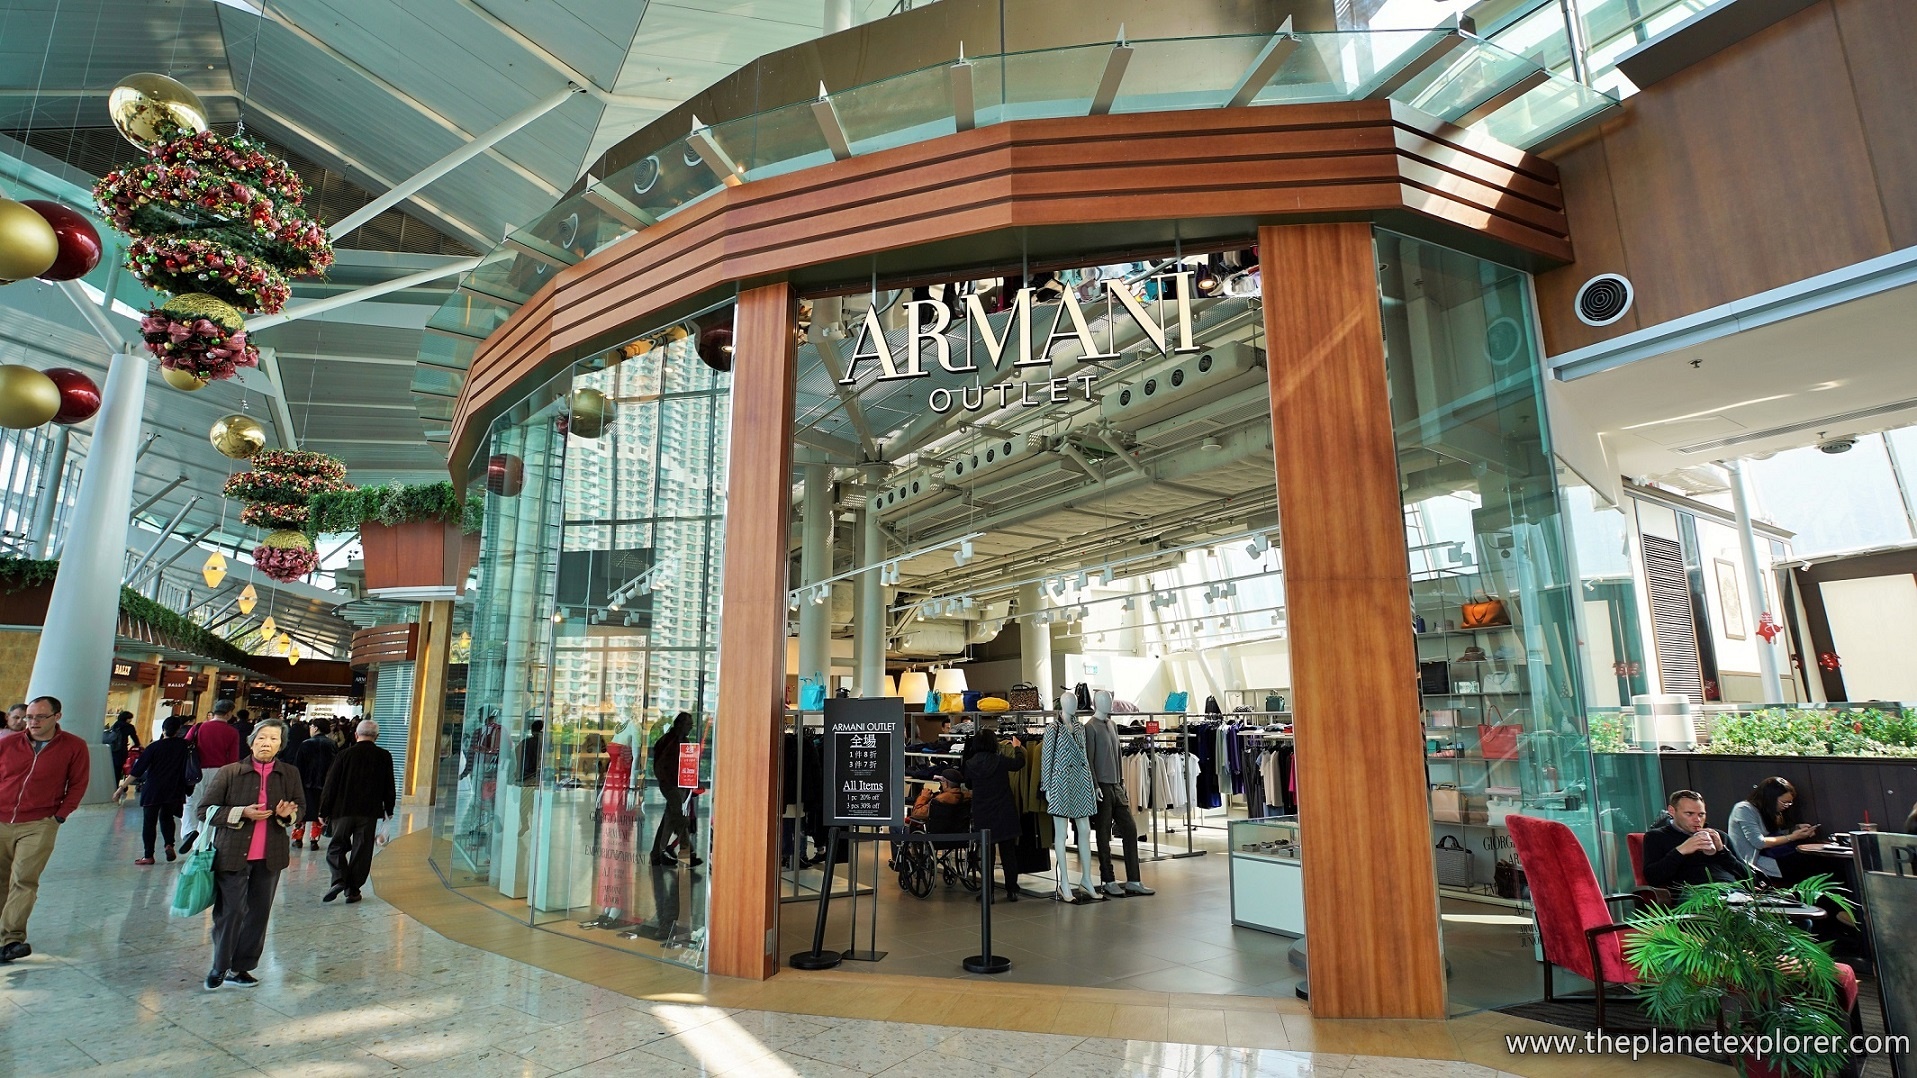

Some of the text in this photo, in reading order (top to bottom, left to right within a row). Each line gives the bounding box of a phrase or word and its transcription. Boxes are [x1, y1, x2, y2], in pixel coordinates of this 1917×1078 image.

[838, 270, 1200, 385] ARMANI
[928, 374, 1099, 413] OUTLET
[114, 664, 132, 676] BALLY
[832, 722, 896, 731] ARMANI OUTLET
[849, 734, 877, 748] 全場
[843, 780, 884, 791] All Items
[872, 793, 881, 801] off
[1483, 834, 1516, 851] GIORG
